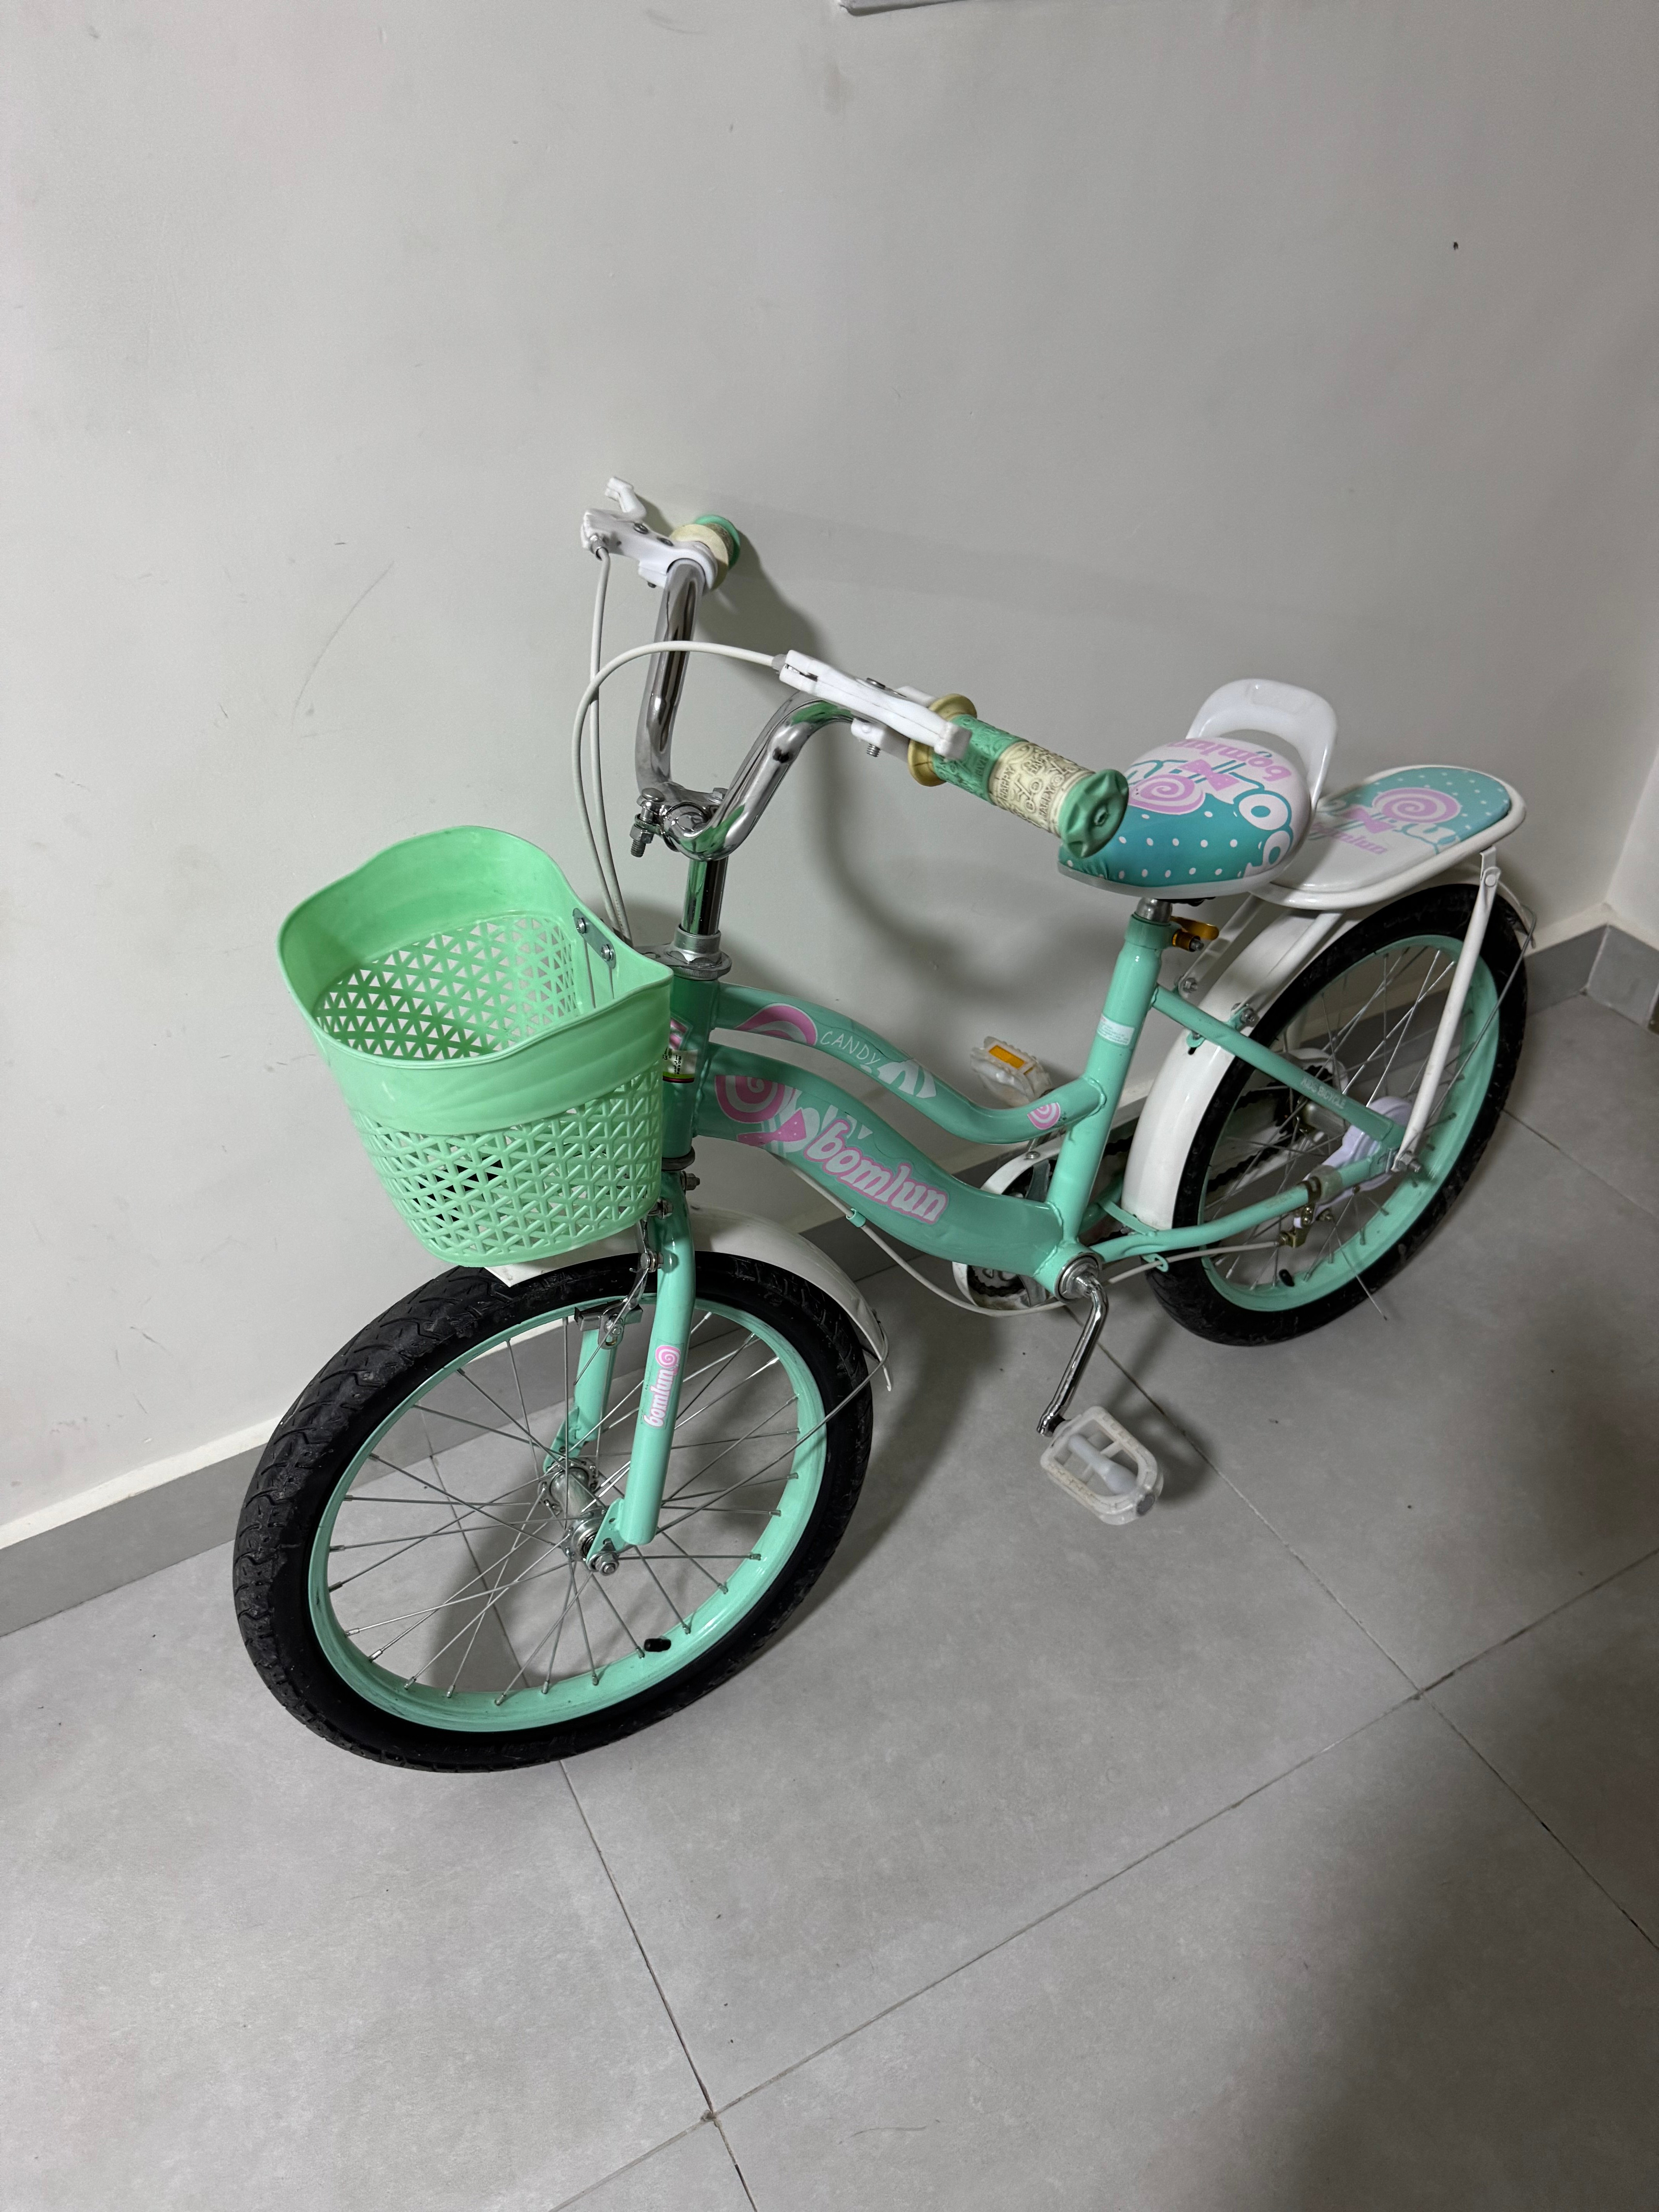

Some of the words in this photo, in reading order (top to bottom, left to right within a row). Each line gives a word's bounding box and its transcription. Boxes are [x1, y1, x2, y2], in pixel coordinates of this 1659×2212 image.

[998, 765, 1015, 802] HAPPY
[820, 1031, 881, 1065] CANDY
[804, 1119, 949, 1225] bomlun
[643, 1368, 675, 1428] bomlun
